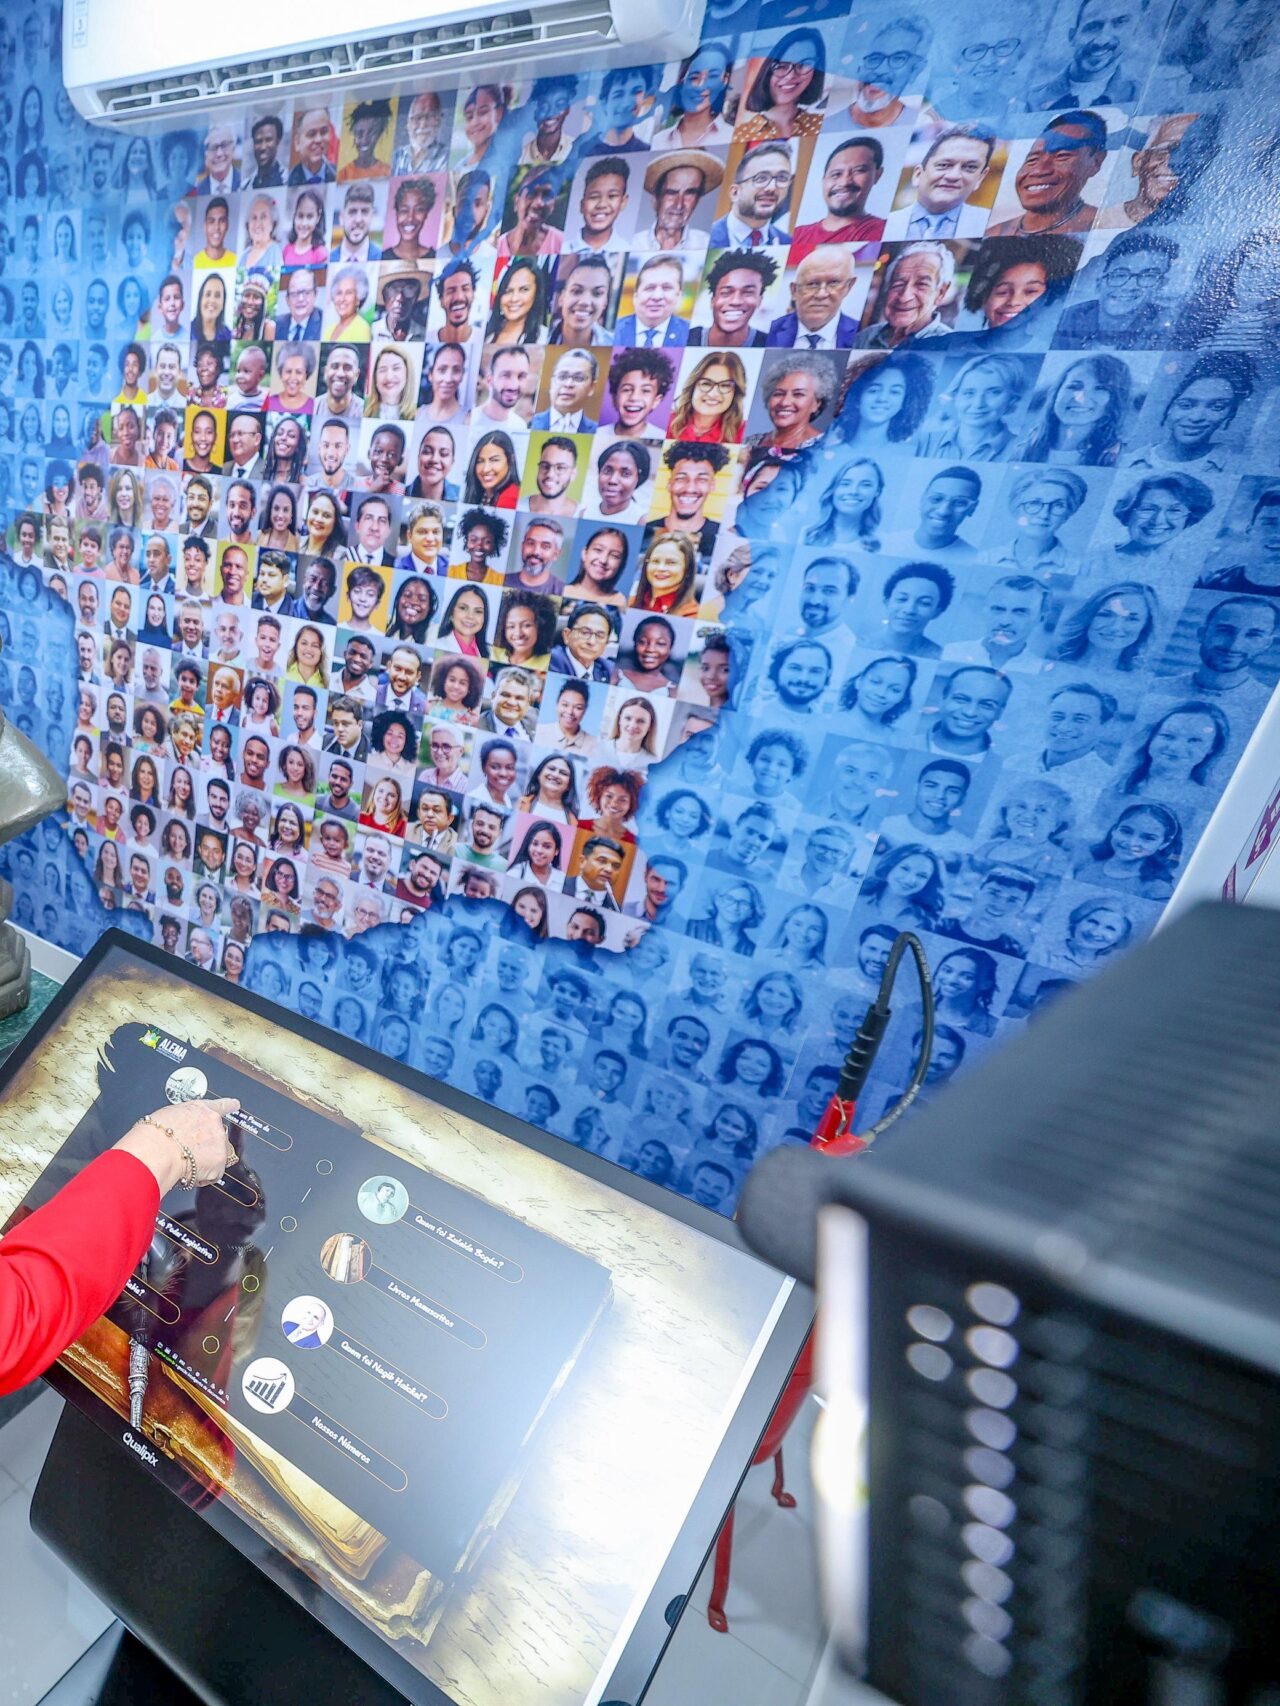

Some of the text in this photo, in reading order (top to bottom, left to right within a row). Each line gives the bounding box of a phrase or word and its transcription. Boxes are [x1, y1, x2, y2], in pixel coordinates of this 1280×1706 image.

[158, 1038, 188, 1060] ALEMA
[165, 1222, 183, 1238] Poder
[181, 1233, 213, 1259] Legislativo
[415, 1215, 436, 1231] Quem
[436, 1227, 447, 1237] foi
[388, 1282, 455, 1328] Livros Manuscritos
[341, 1341, 362, 1359] Quem
[361, 1355, 373, 1366] foi
[371, 1362, 395, 1381] Nagib
[122, 1432, 159, 1467] Qualipix
[311, 1416, 371, 1464] Nossos Números
